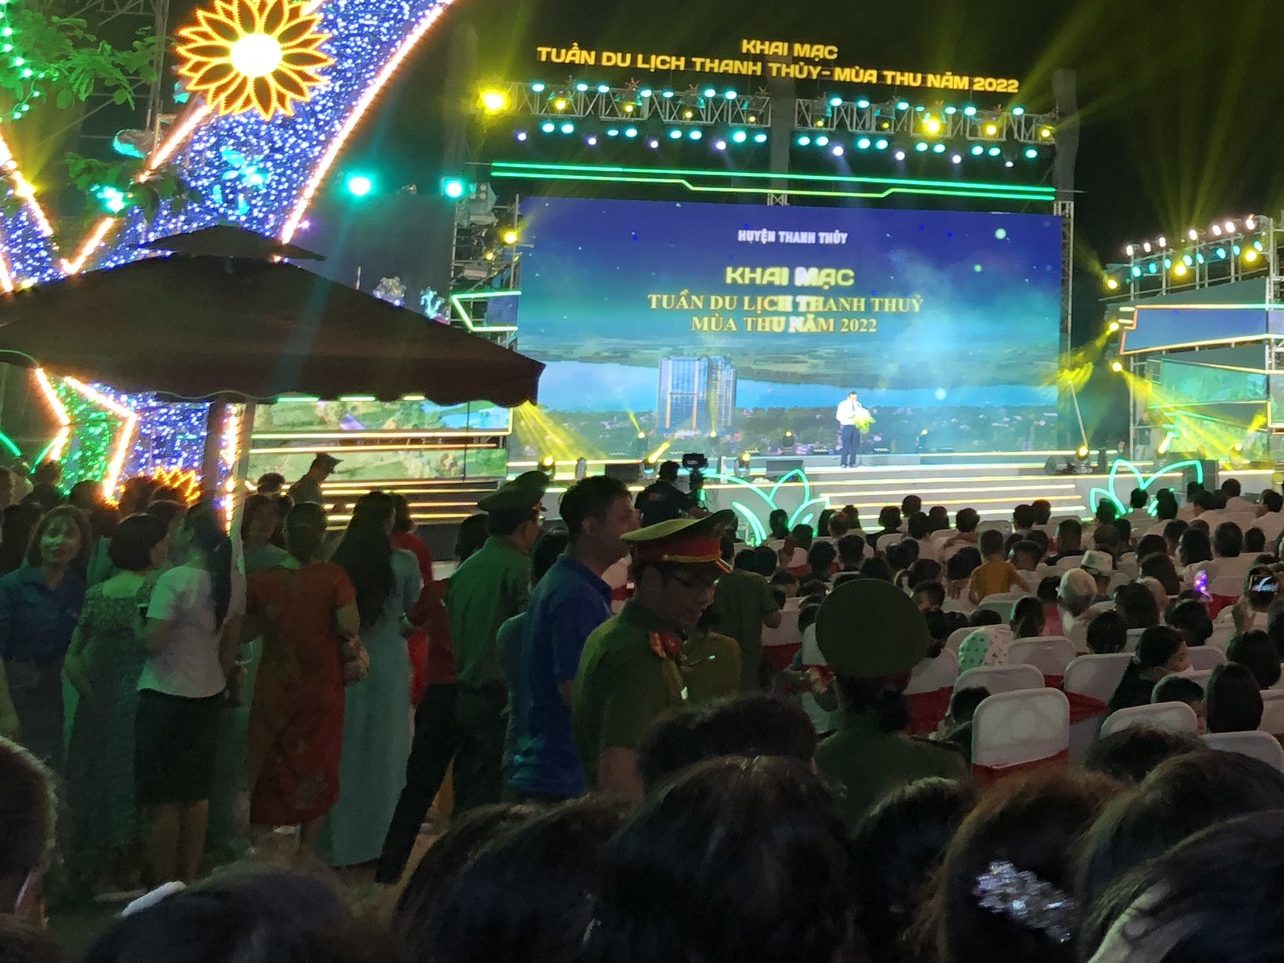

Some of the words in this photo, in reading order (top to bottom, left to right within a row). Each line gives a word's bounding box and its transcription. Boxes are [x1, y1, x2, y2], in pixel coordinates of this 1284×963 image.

[741, 39, 788, 57] KHAI
[793, 43, 839, 62] MẠC
[601, 51, 632, 68] DU
[637, 54, 685, 72] LỊCH
[691, 57, 763, 77] THANH
[882, 70, 922, 87] THU
[926, 71, 970, 90] NĂM
[973, 77, 1020, 93] 2022
[737, 227, 776, 245] HUYỆN
[778, 230, 816, 244] THANH
[818, 229, 849, 244] THỦY
[725, 267, 790, 286] KHAI
[794, 267, 856, 290] MẠC
[709, 295, 738, 311] DU
[743, 295, 794, 314] LỊCH
[795, 295, 866, 313] THANH
[691, 312, 738, 332] MÙA
[743, 316, 787, 333] THU
[788, 313, 835, 334] NĂM
[840, 318, 878, 333] 2022
